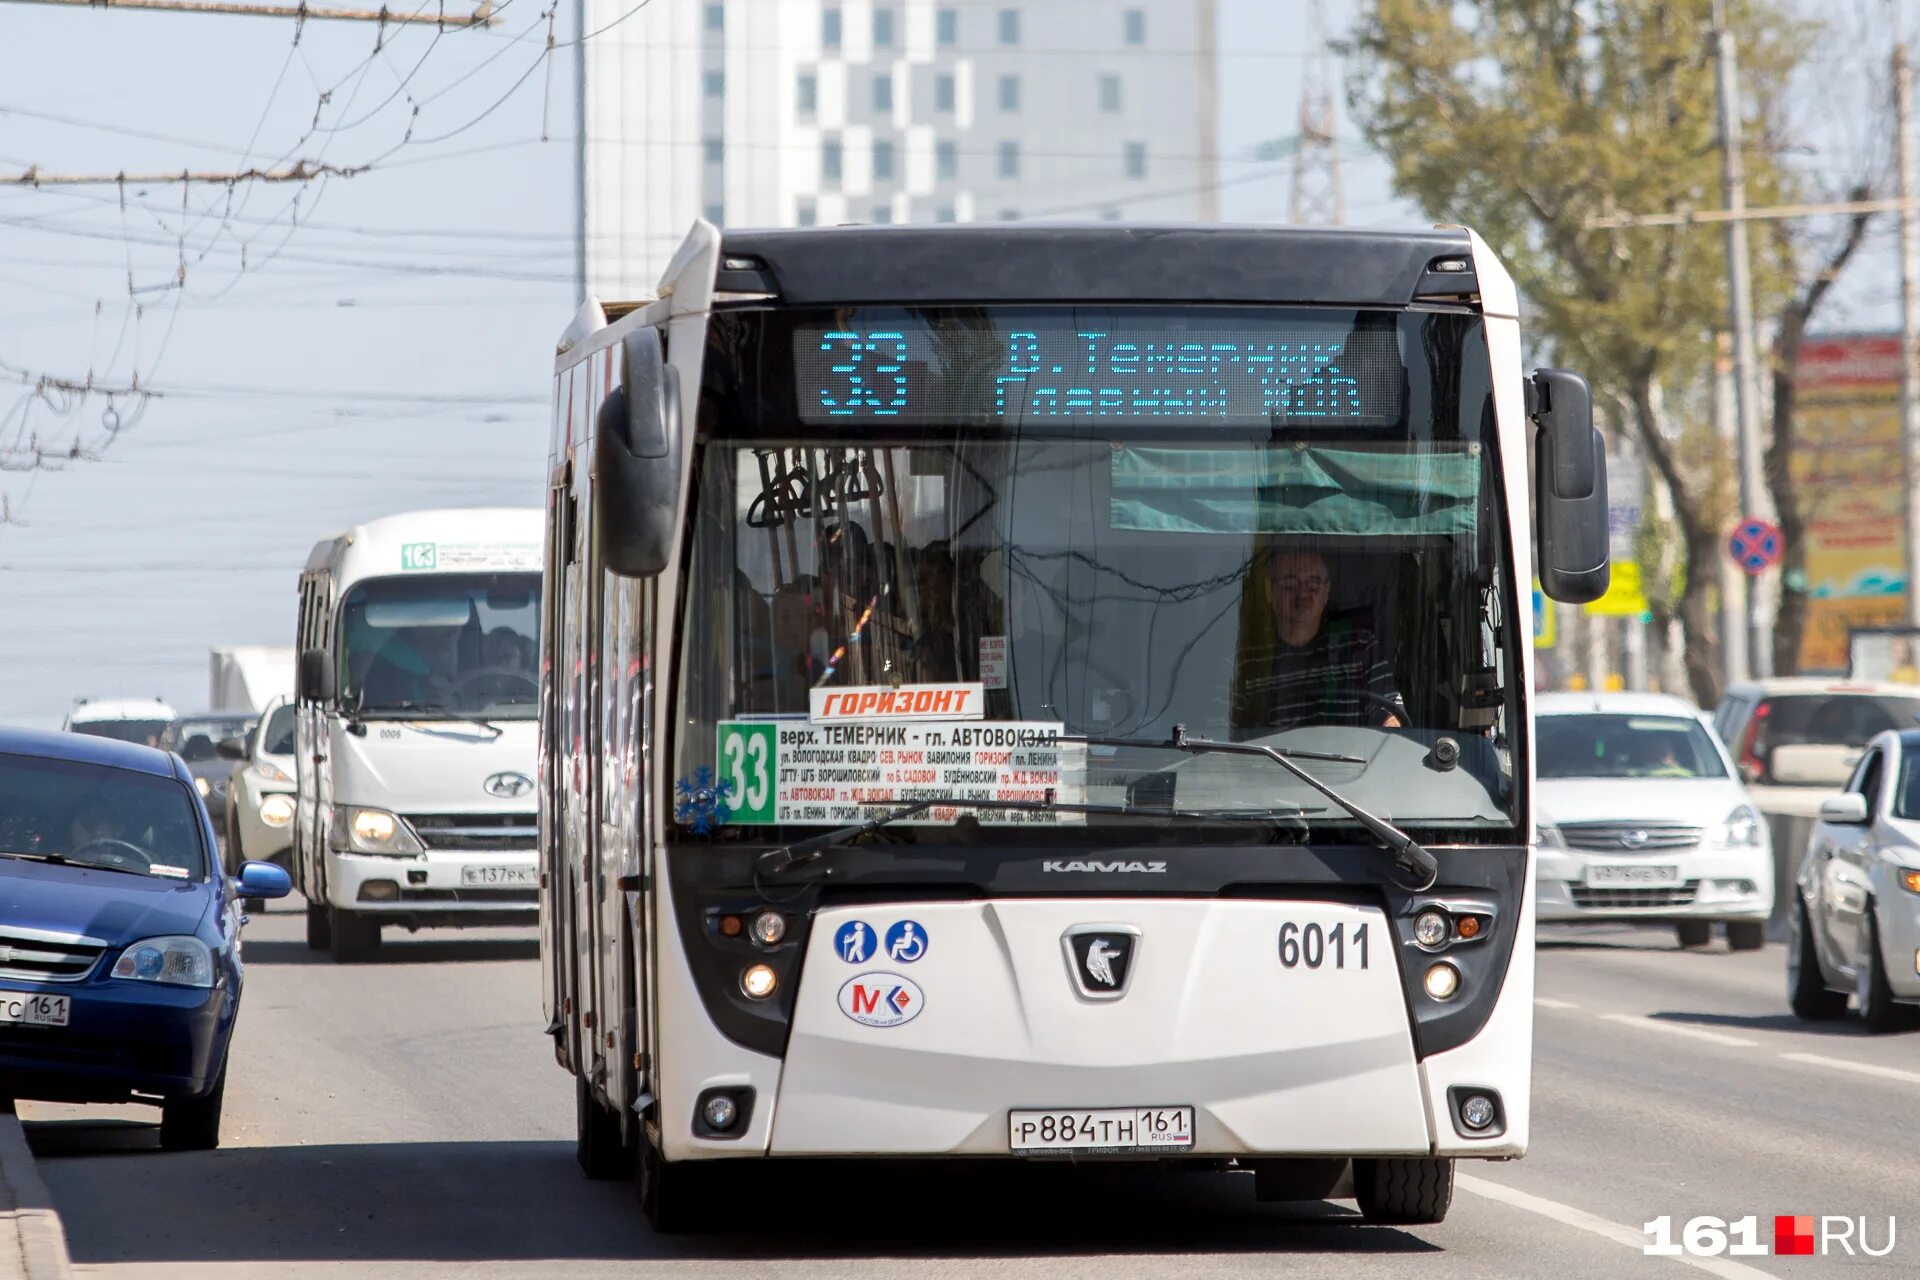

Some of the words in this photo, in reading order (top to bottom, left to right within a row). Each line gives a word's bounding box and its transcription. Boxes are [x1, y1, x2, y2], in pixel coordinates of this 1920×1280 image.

[821, 332, 907, 416] 33
[996, 377, 1228, 416] Главный
[822, 690, 972, 717] ГОРИЗОНТ
[780, 730, 819, 749] верх.
[823, 726, 907, 747] ТЕМЕРНИК
[925, 732, 946, 747] гл.
[951, 728, 1058, 748] АВТОВОКЗАЛ
[792, 750, 844, 766] ВОЛОГОДСКАЯ
[847, 751, 876, 767] КВАДРО
[879, 751, 895, 764] СЕВ.
[897, 752, 923, 765] РЫНОК
[926, 752, 971, 765] ВАВИЛОНИЯ
[974, 752, 1013, 766] ГОРИЗОНТ
[1027, 752, 1057, 767] ЛЕНИНА
[724, 732, 769, 812] 33
[818, 767, 881, 783] ВОРОШИЛОВСКИЙ
[904, 769, 937, 784] САДОВОЙ
[1030, 771, 1058, 785] ВОКЗАЛ
[790, 788, 835, 801] АВТОВОКЗАЛ
[867, 788, 893, 801] ВОКЗАЛ
[1043, 861, 1167, 873] KAMAZ
[1278, 921, 1369, 970] 6011
[30, 996, 64, 1016] 161
[1021, 1114, 1134, 1143] Р884ТН
[1141, 1111, 1183, 1133] 161
[1151, 1133, 1173, 1142] RUS
